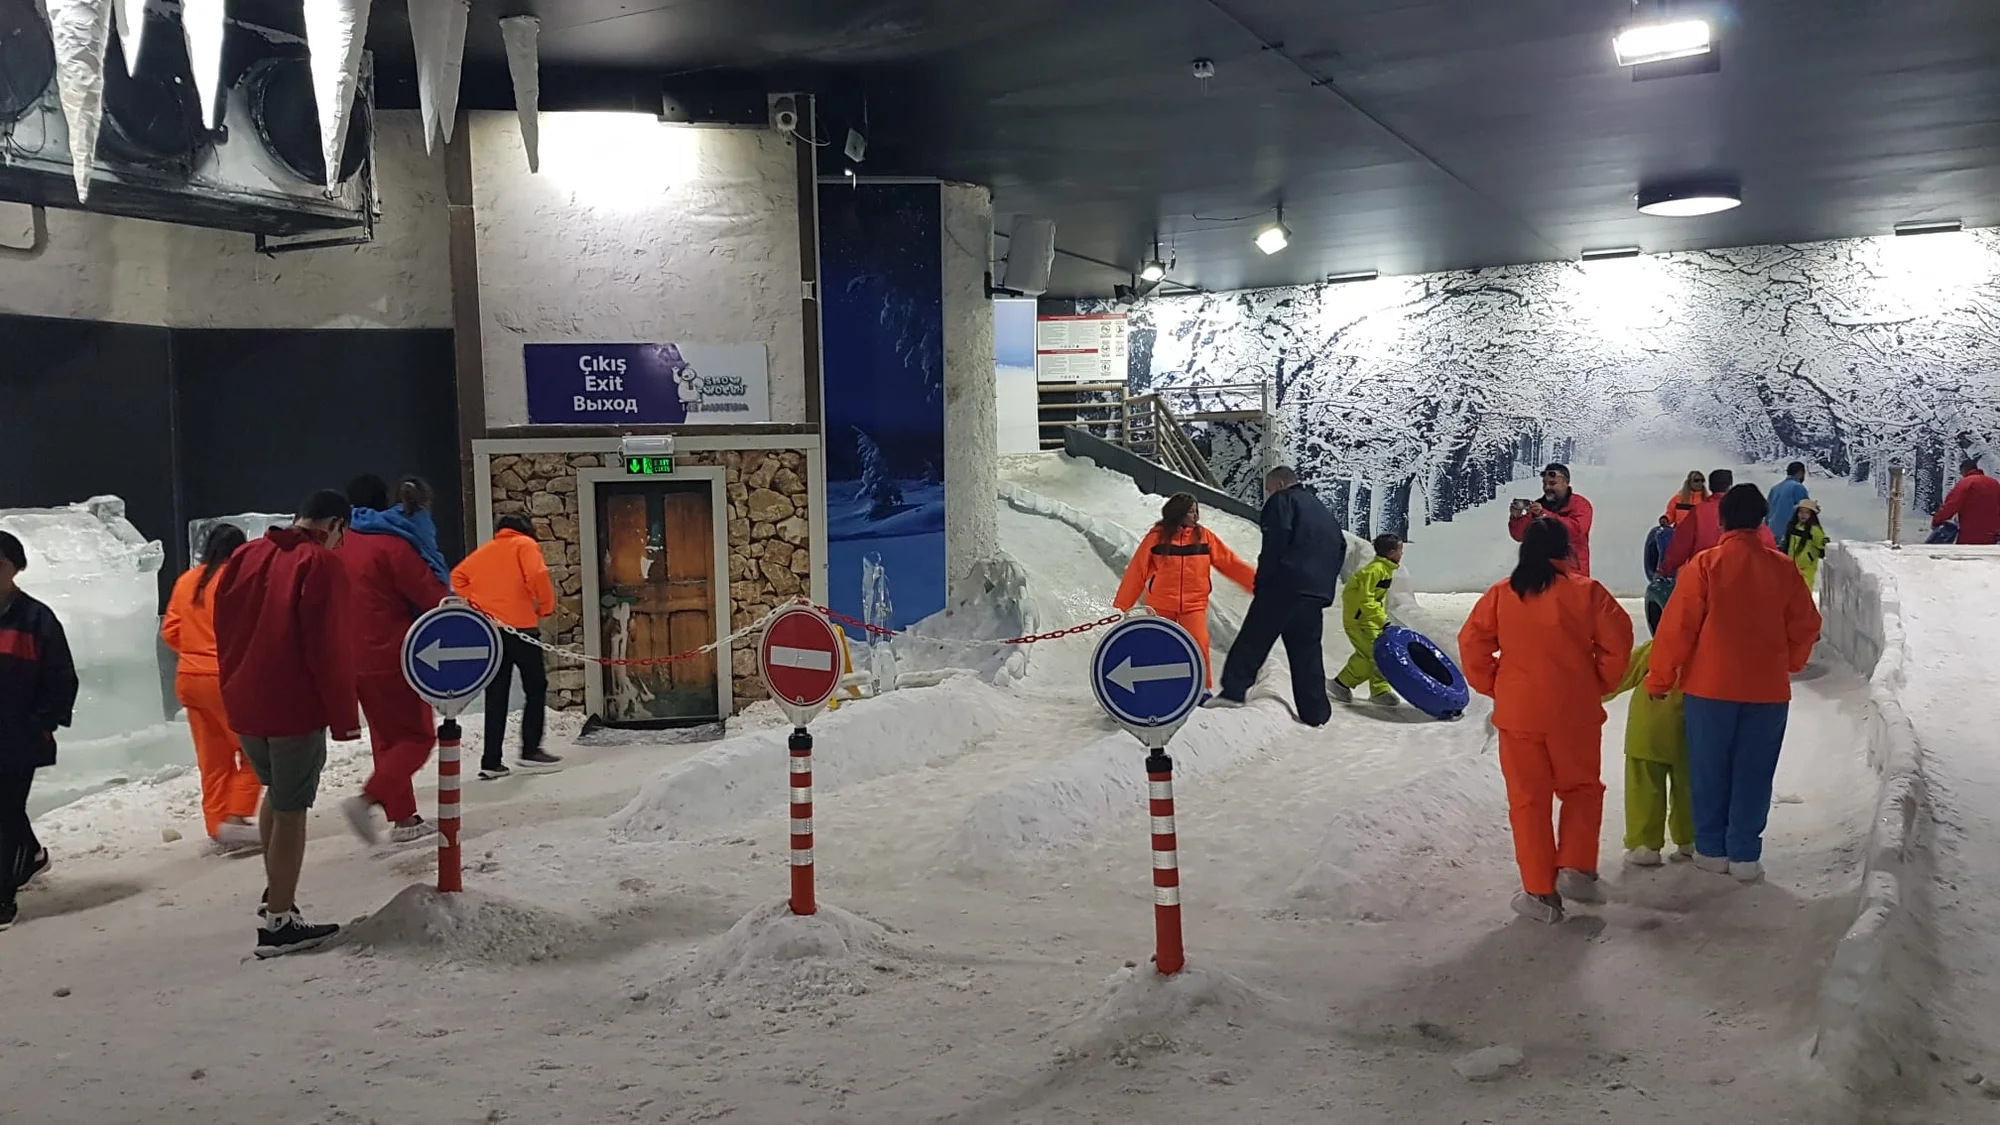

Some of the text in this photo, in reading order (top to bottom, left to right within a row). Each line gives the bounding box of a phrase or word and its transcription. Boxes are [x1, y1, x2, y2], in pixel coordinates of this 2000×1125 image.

[579, 355, 627, 375] Çıkış
[585, 375, 623, 391] Exit
[573, 395, 638, 414] Выход
